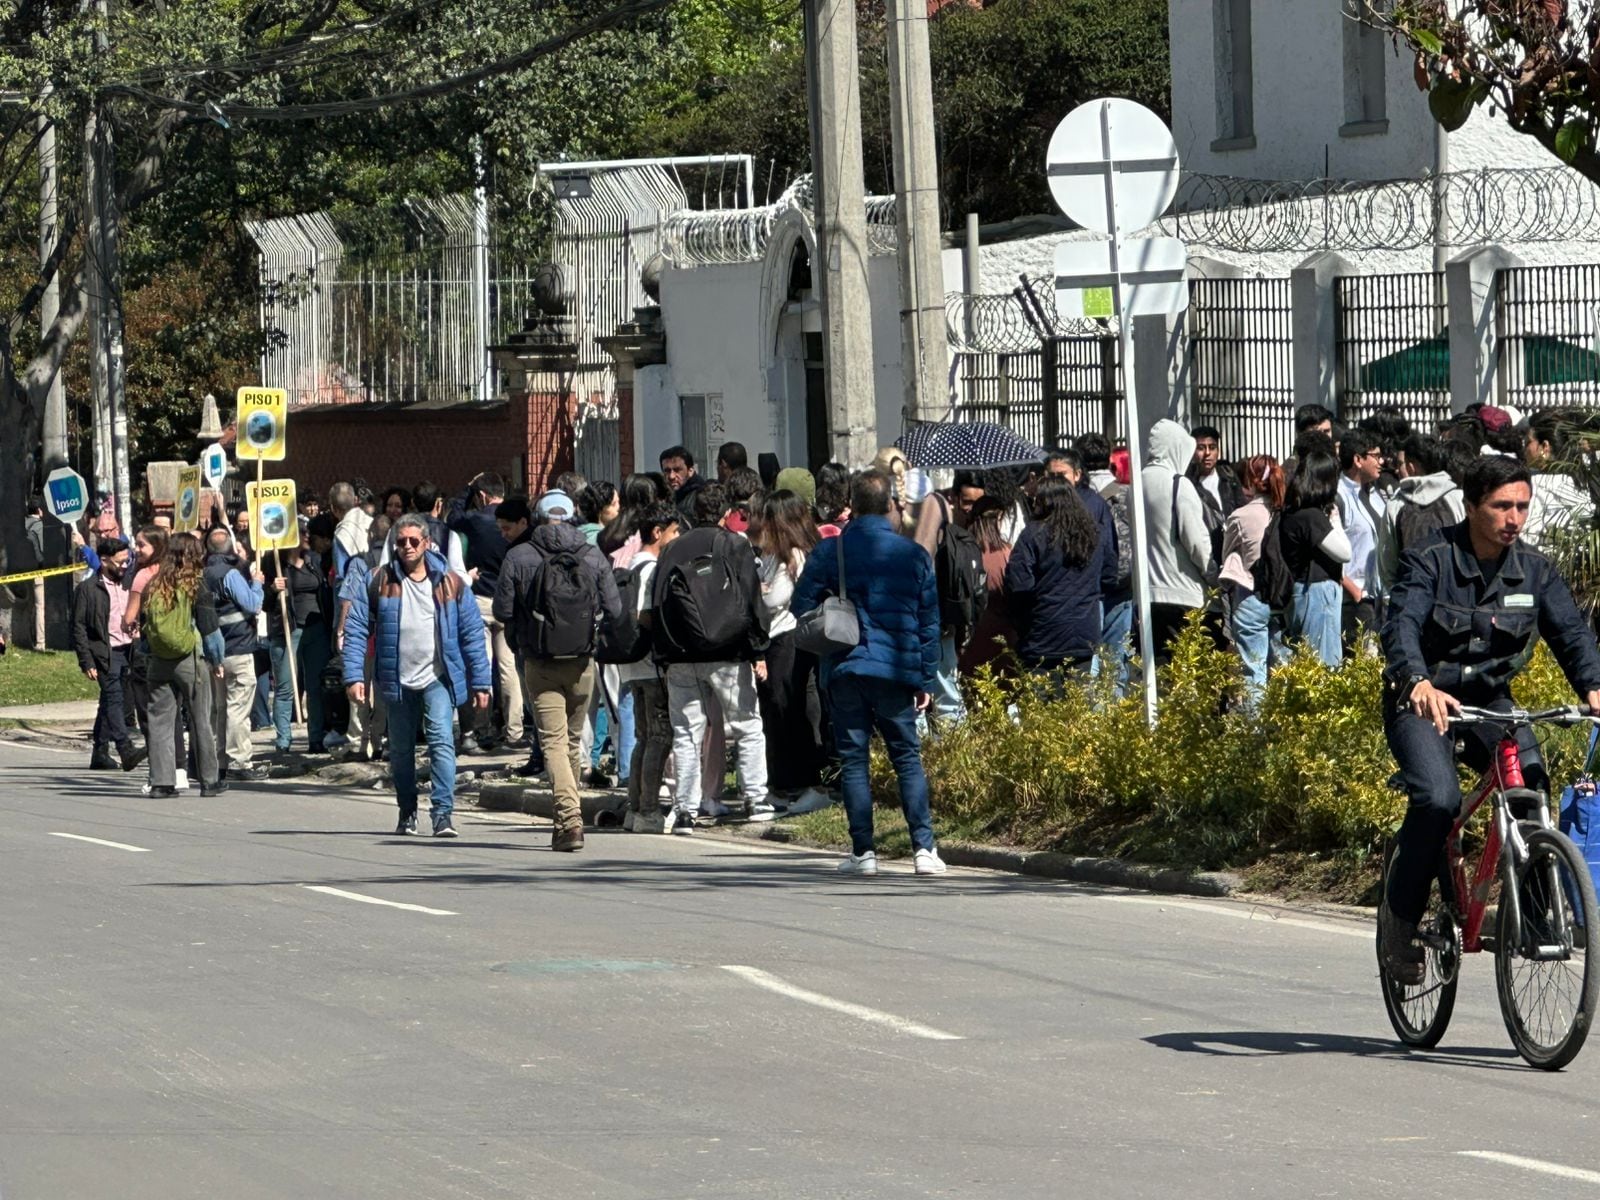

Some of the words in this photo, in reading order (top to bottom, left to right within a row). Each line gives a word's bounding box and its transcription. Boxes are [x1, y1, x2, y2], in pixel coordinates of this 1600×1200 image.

[245, 393, 272, 406] PISO
[275, 394, 280, 406] 1
[281, 485, 289, 497] 2
[56, 497, 80, 511] Ipsos
